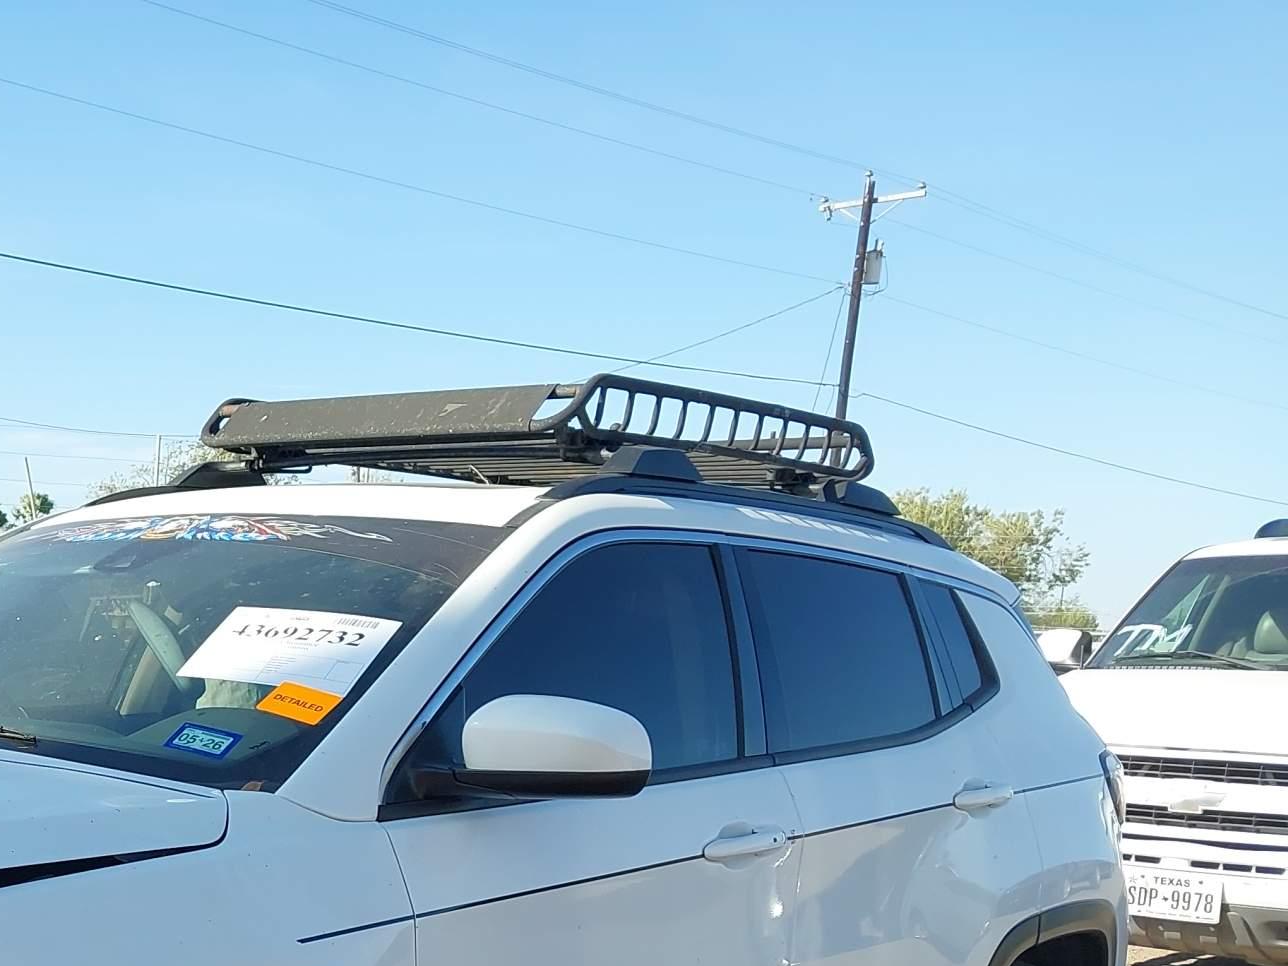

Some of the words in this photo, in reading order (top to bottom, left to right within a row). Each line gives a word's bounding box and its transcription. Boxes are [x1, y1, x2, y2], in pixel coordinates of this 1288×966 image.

[232, 624, 366, 647] 43692732
[273, 693, 324, 713] DETAILED
[1153, 876, 1191, 887] TEXAS
